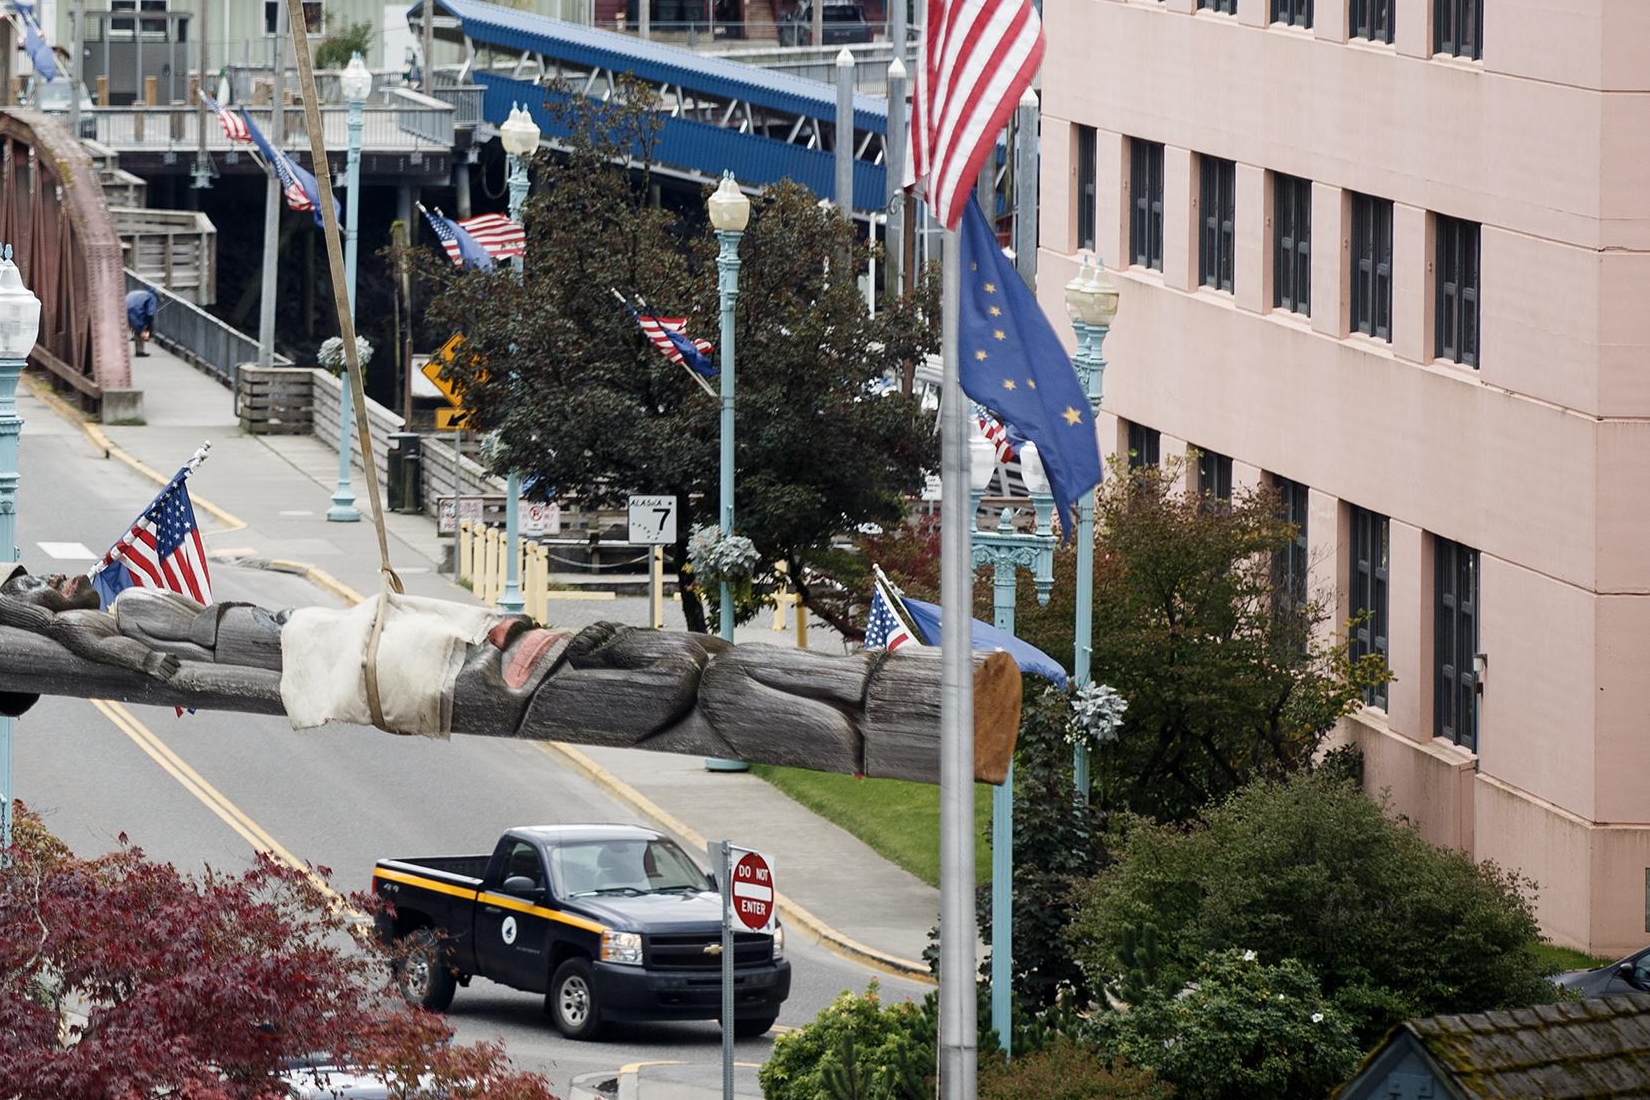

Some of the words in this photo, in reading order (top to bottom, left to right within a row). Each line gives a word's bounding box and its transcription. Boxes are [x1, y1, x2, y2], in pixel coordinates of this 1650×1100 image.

[652, 508, 671, 531] 7
[738, 864, 751, 878] DO
[755, 868, 769, 881] NOT
[741, 899, 766, 915] ENTER
